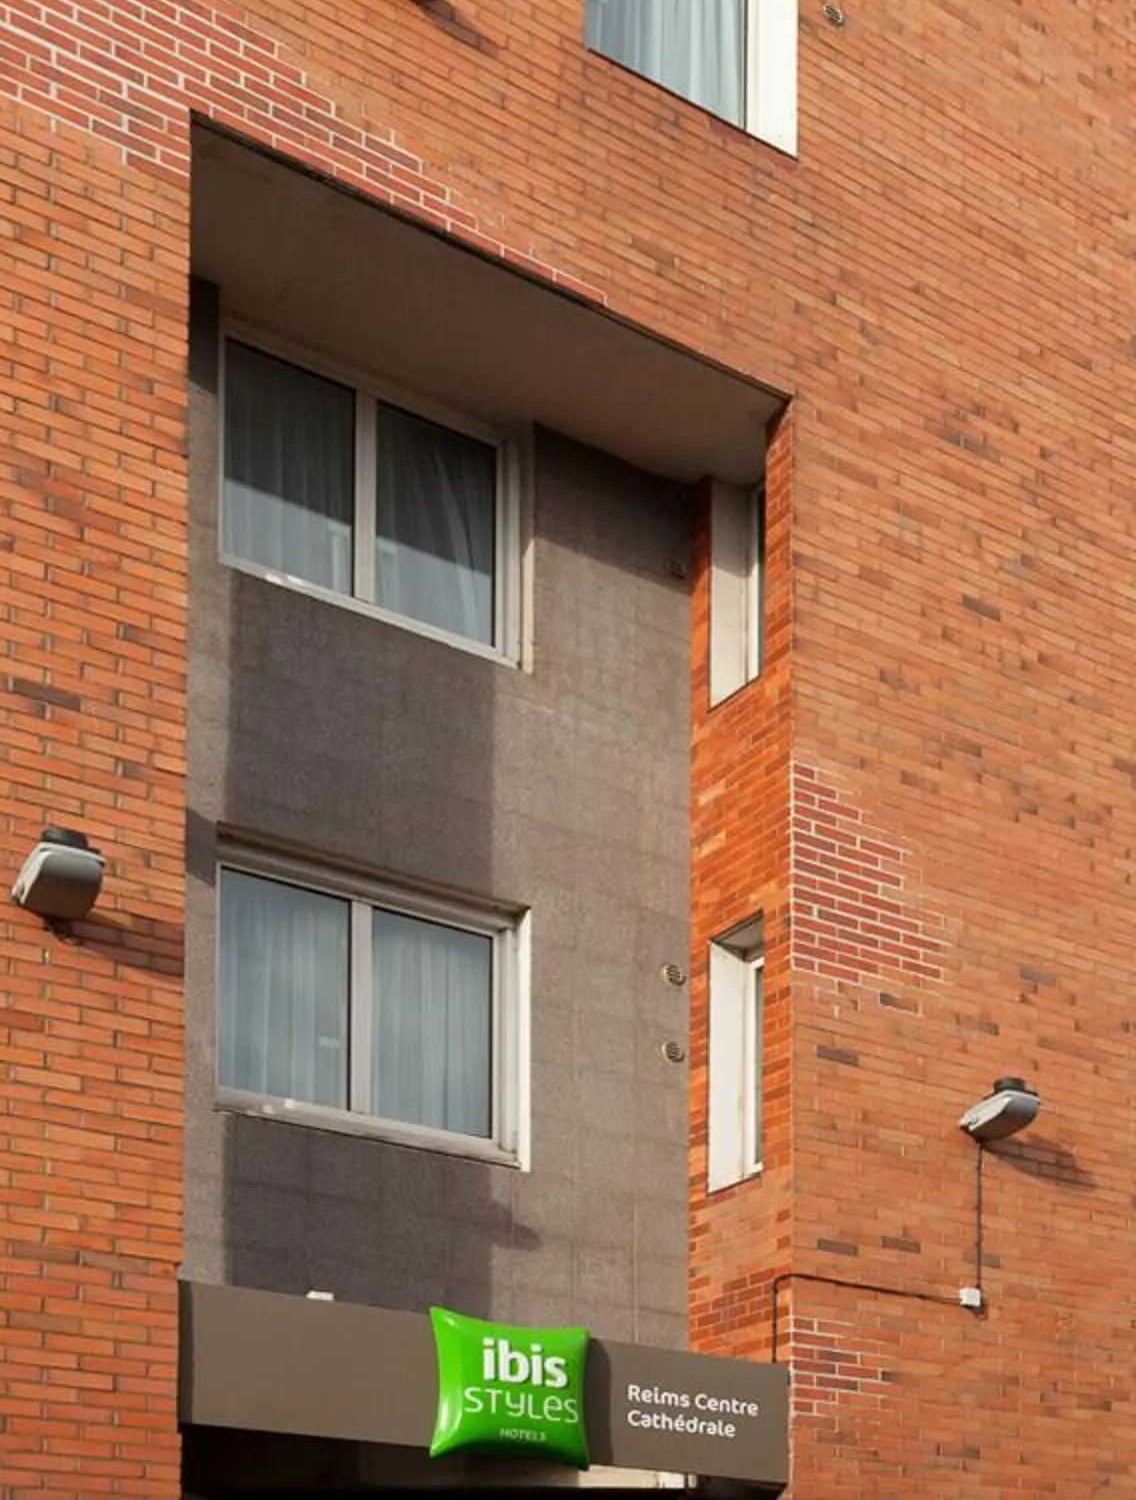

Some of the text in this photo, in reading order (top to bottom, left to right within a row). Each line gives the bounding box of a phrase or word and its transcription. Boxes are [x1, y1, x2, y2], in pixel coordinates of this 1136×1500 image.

[482, 1336, 569, 1389] ibis
[627, 1384, 759, 1417] Reims Centre
[499, 1427, 547, 1442] HOTELS
[627, 1409, 737, 1438] Cathédrale
